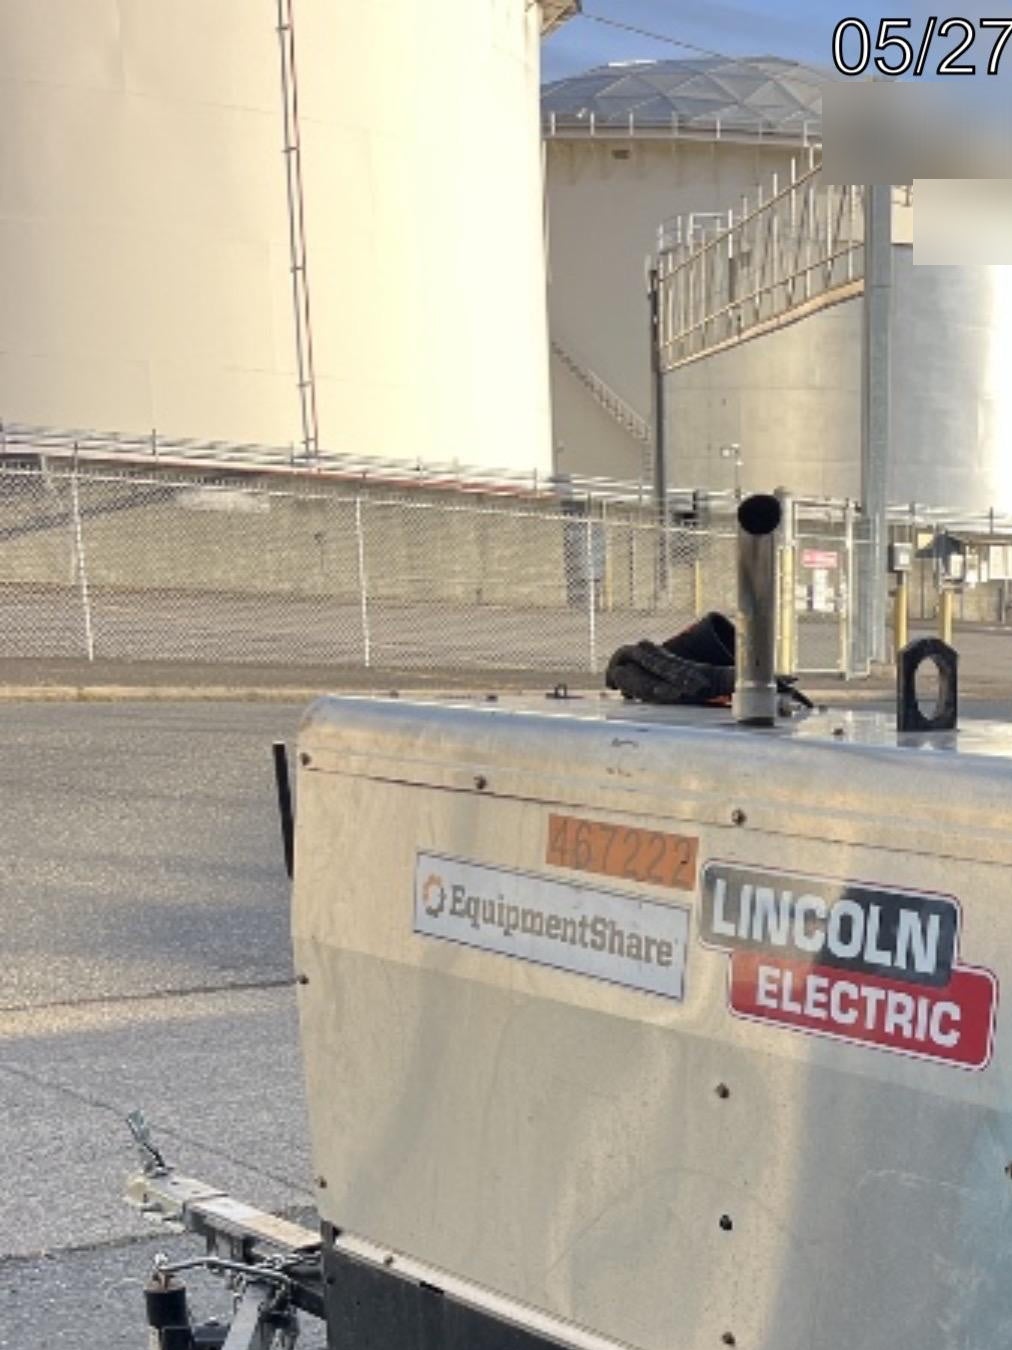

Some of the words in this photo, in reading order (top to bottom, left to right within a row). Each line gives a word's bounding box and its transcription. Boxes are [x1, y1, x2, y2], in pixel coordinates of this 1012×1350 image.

[550, 818, 691, 887] 467222
[450, 884, 673, 967] EquipmentShare
[712, 879, 940, 975] LINCOLN
[756, 965, 961, 1048] ELECTRIC
